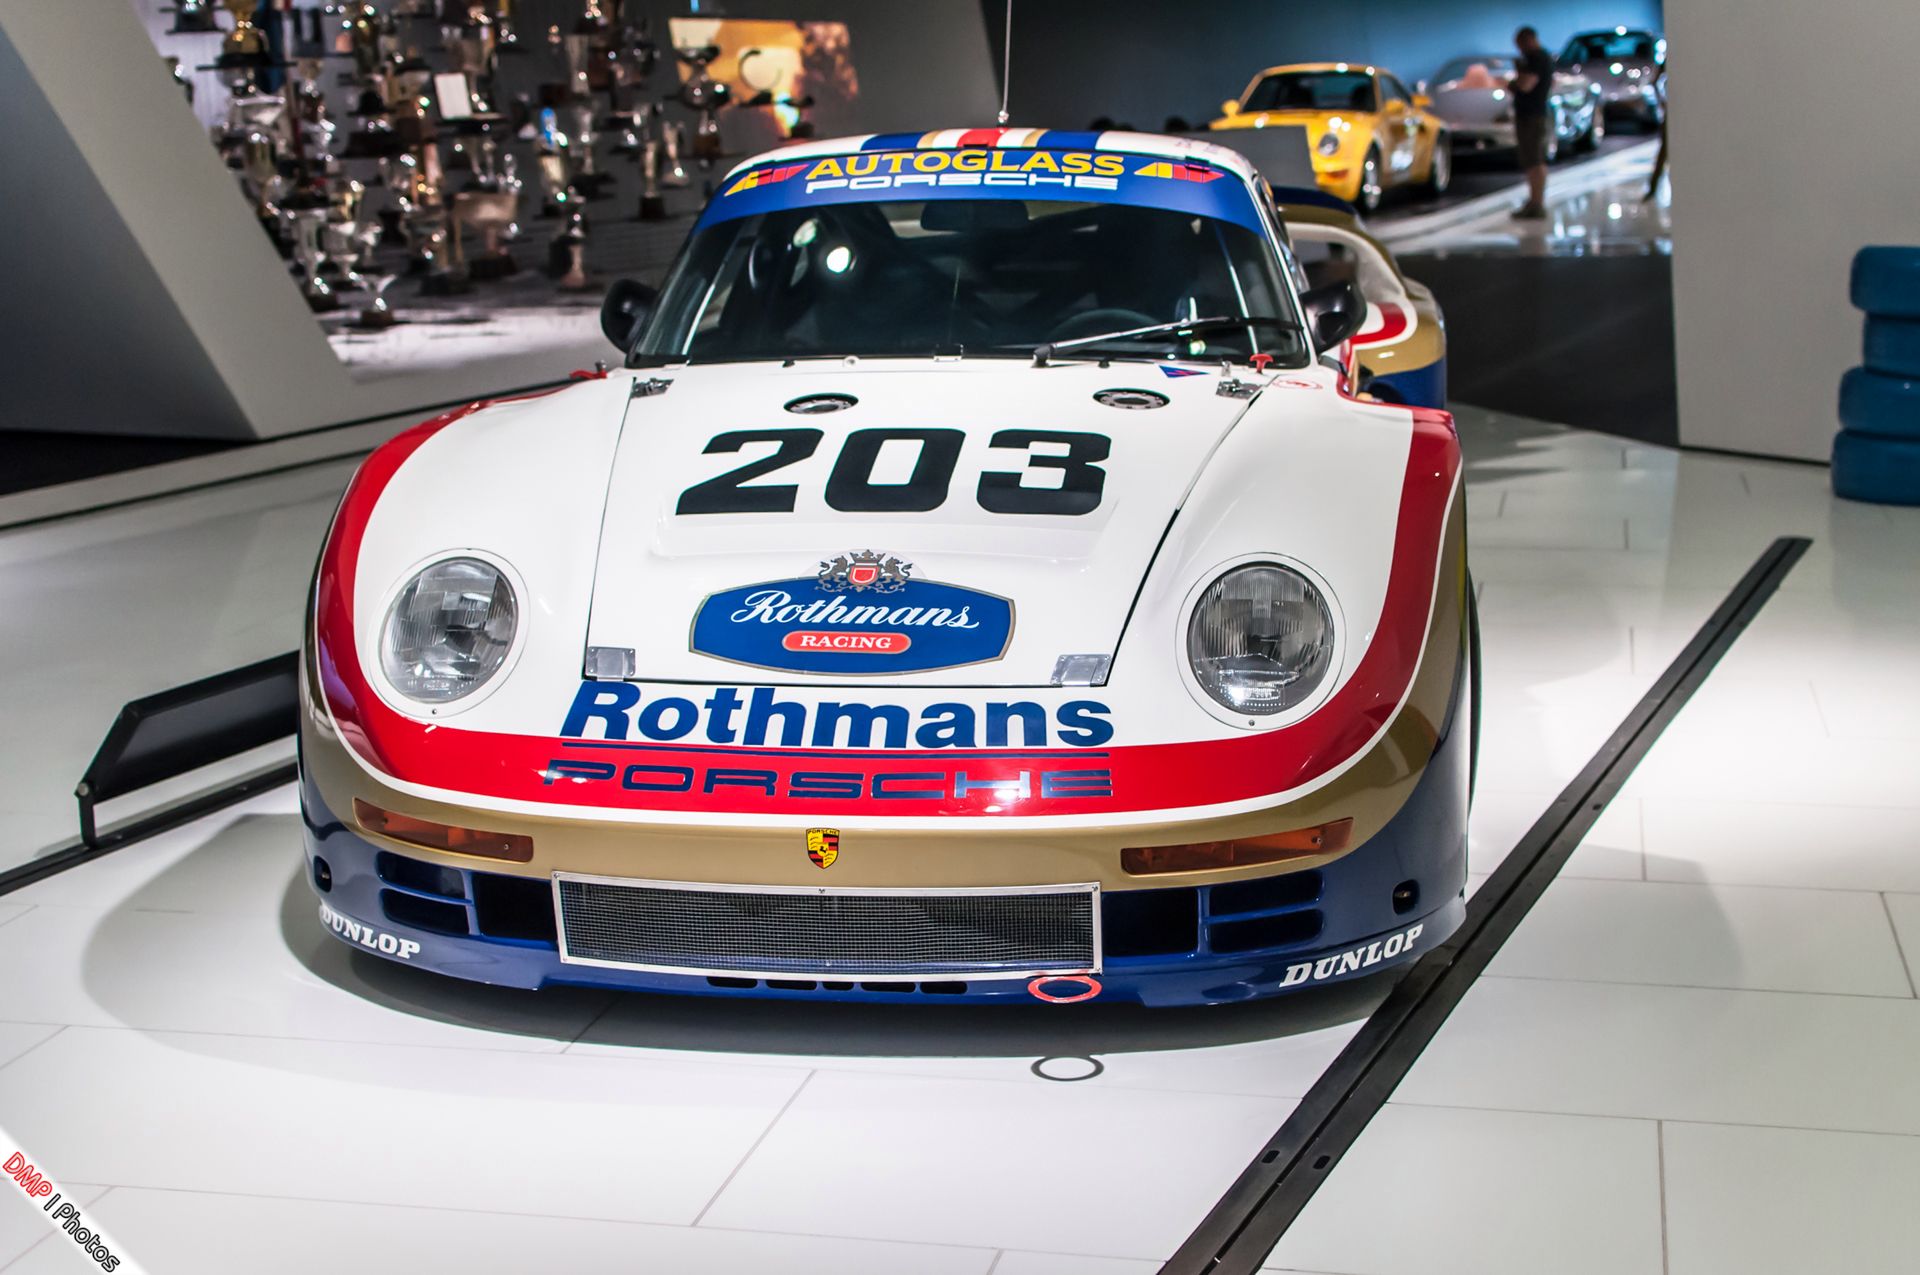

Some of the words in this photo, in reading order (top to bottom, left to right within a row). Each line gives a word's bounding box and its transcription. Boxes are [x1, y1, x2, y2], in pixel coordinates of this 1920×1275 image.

[805, 172, 1118, 195] PORSCHE
[806, 150, 1125, 179] AUTOGLASS
[675, 428, 1112, 516] 203
[730, 589, 980, 629] Rothmans
[800, 634, 892, 650] RACING
[561, 681, 1114, 749] Rothmans
[543, 759, 1112, 799] PORSCHE
[320, 905, 421, 959] DUNLOP
[1279, 923, 1424, 988] DUNLOP
